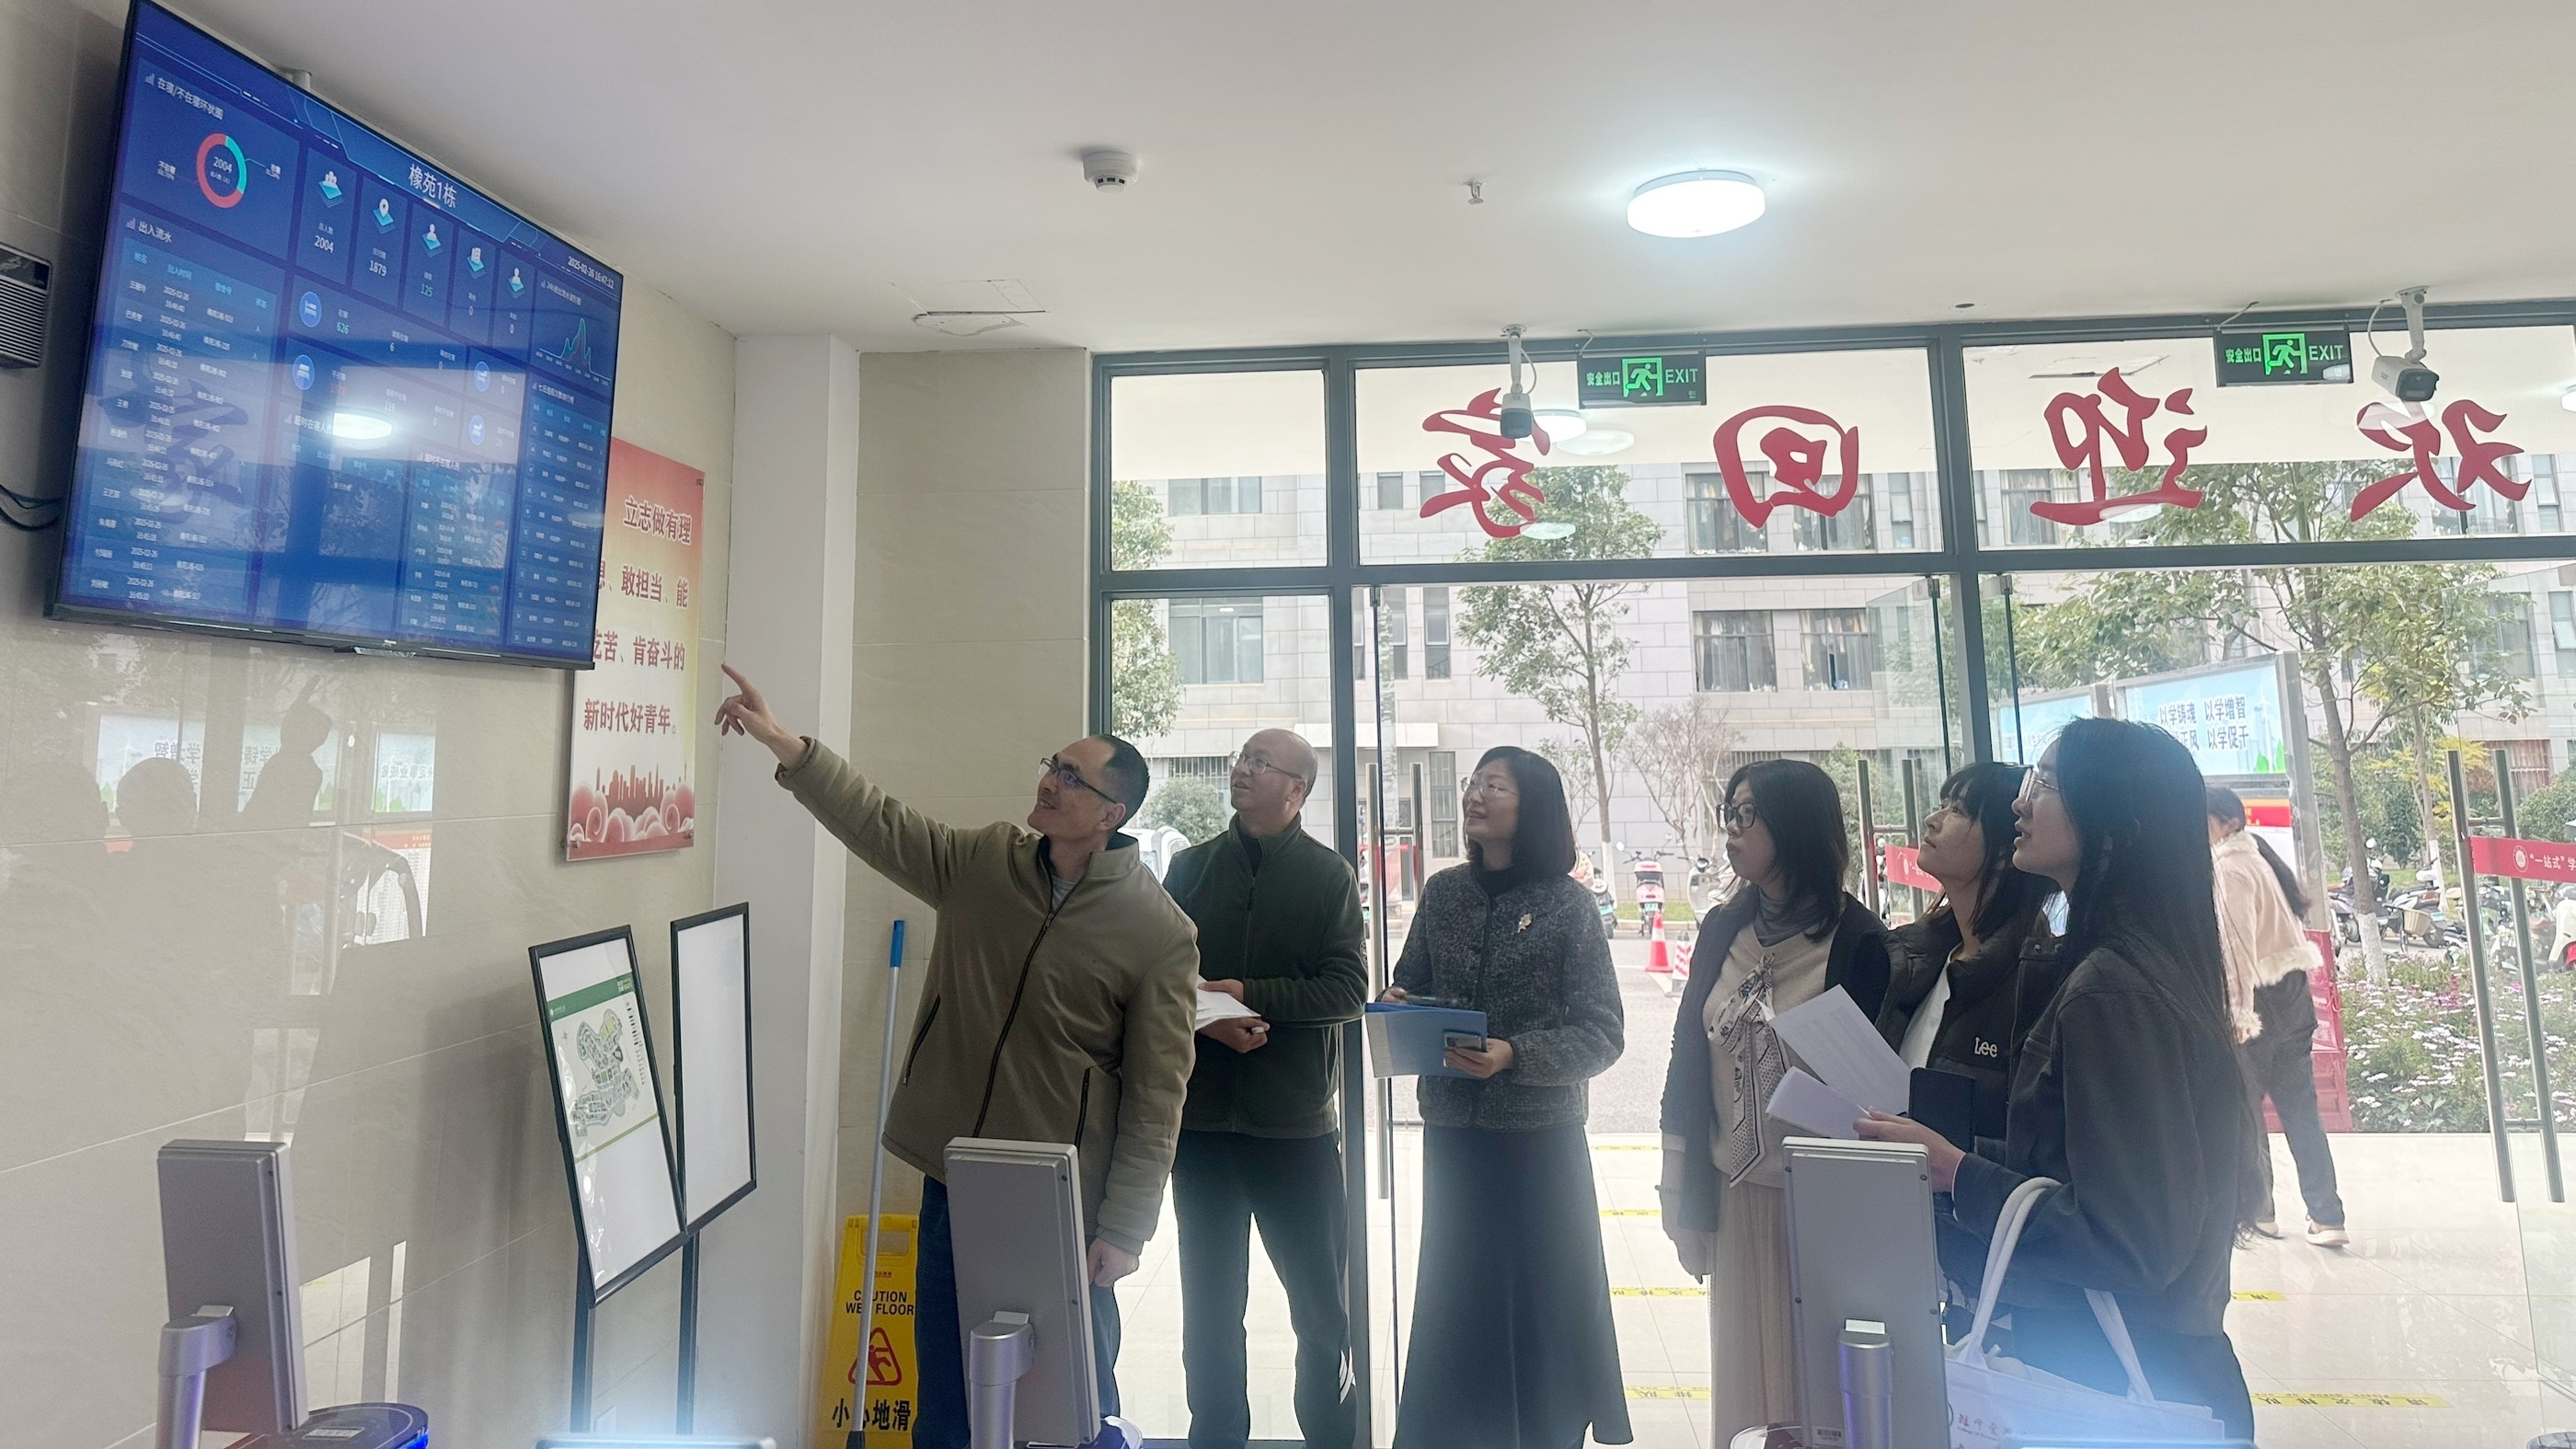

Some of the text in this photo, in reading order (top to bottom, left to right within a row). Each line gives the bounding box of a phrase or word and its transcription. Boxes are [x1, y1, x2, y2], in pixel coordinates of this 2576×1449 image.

[213, 155, 232, 174] 2004
[409, 163, 457, 209] 橡苑1栋
[138, 220, 172, 244] 出入流水
[314, 234, 334, 254] 2004
[369, 259, 386, 278] 1879
[568, 255, 594, 279] 2025-02-26
[420, 282, 432, 298] 125
[467, 304, 473, 316] 0
[336, 320, 349, 336] 626
[509, 322, 514, 335] 0
[389, 340, 395, 352] 6
[2308, 345, 2343, 361] EXIT
[2225, 347, 2261, 363] 安全出口
[1586, 371, 1620, 386] 安全出口
[1665, 368, 1698, 384] EXIT
[623, 495, 692, 544] 立志做有理
[583, 698, 676, 735] 新时代好青年。
[2159, 696, 2246, 726] 以学铸魂 以学增智
[2207, 725, 2248, 750] 以学促干
[1974, 1037, 1997, 1058] Lee
[854, 1290, 907, 1303] CUTION
[845, 1302, 914, 1316] WE FLOOR
